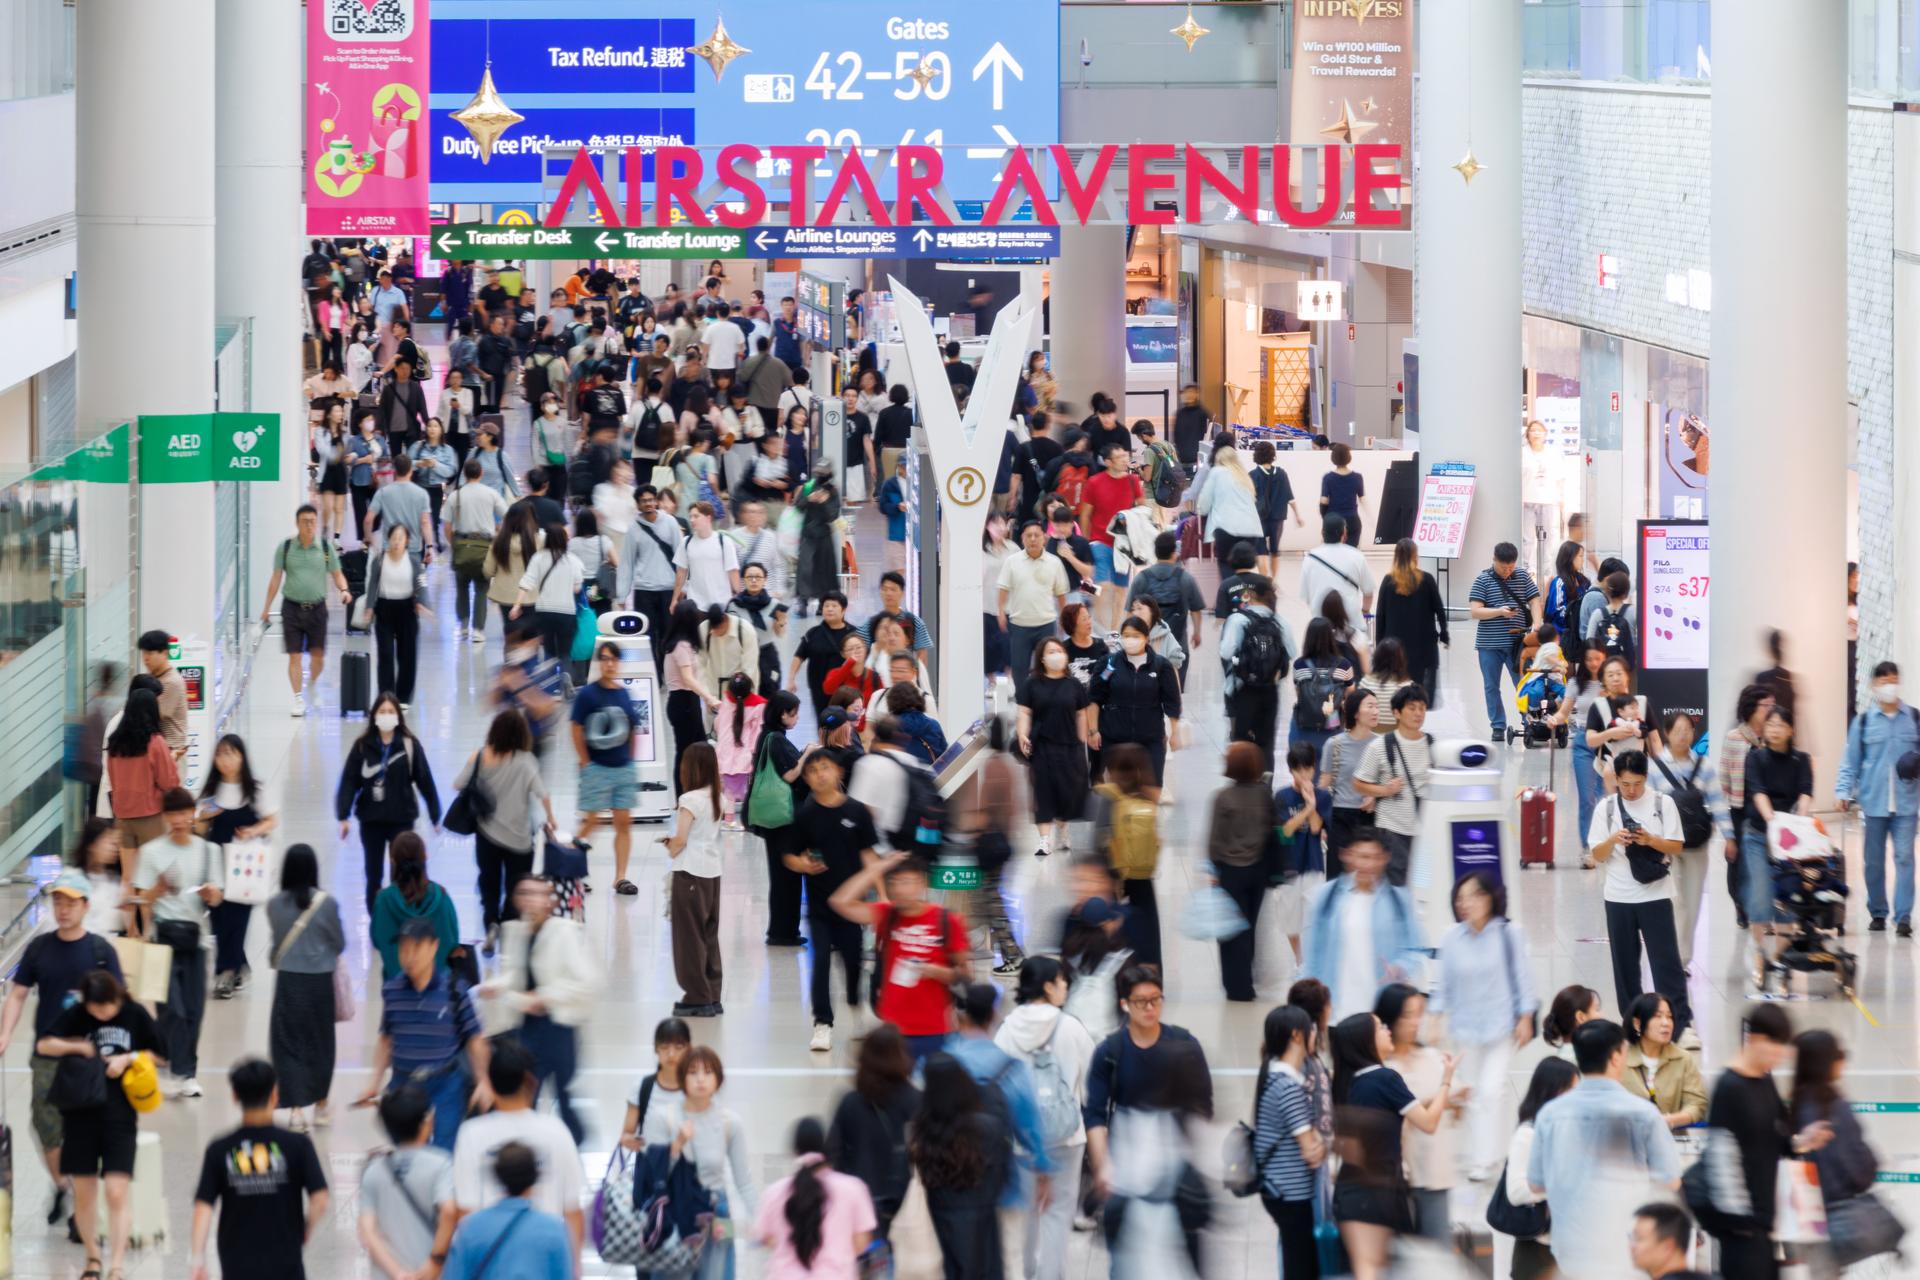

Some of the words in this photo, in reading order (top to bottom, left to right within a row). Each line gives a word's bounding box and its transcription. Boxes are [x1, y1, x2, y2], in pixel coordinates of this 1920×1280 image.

[1303, 1, 1325, 17] IN
[887, 16, 949, 40] Gates
[1303, 42, 1324, 52] Win
[1326, 44, 1333, 52] a
[1366, 42, 1401, 52] Million
[548, 48, 579, 66] Tax
[582, 46, 648, 68] Refund,
[651, 47, 685, 68] 退税
[1320, 54, 1346, 64] Gold
[1349, 54, 1372, 64] Star
[1374, 55, 1382, 64] &
[804, 51, 952, 100] 42-50
[1310, 66, 1343, 76] Travel
[1345, 66, 1396, 76] Rewards!
[443, 136, 480, 159] Duty
[544, 144, 954, 227] AIRSTAR
[980, 143, 1400, 227] AVENUE
[357, 216, 396, 225] AIRSTAR
[466, 230, 532, 244] Transfer
[534, 230, 572, 244] Desk
[624, 232, 684, 248] Transfer
[685, 232, 741, 252] Lounge
[784, 228, 834, 243] Airline
[836, 228, 896, 246] Lounges
[168, 435, 201, 449] AED
[229, 456, 261, 468] AED
[1439, 486, 1471, 494] AIRSTAR
[1419, 523, 1446, 543] 50%
[1667, 538, 1696, 549] SPECIAL
